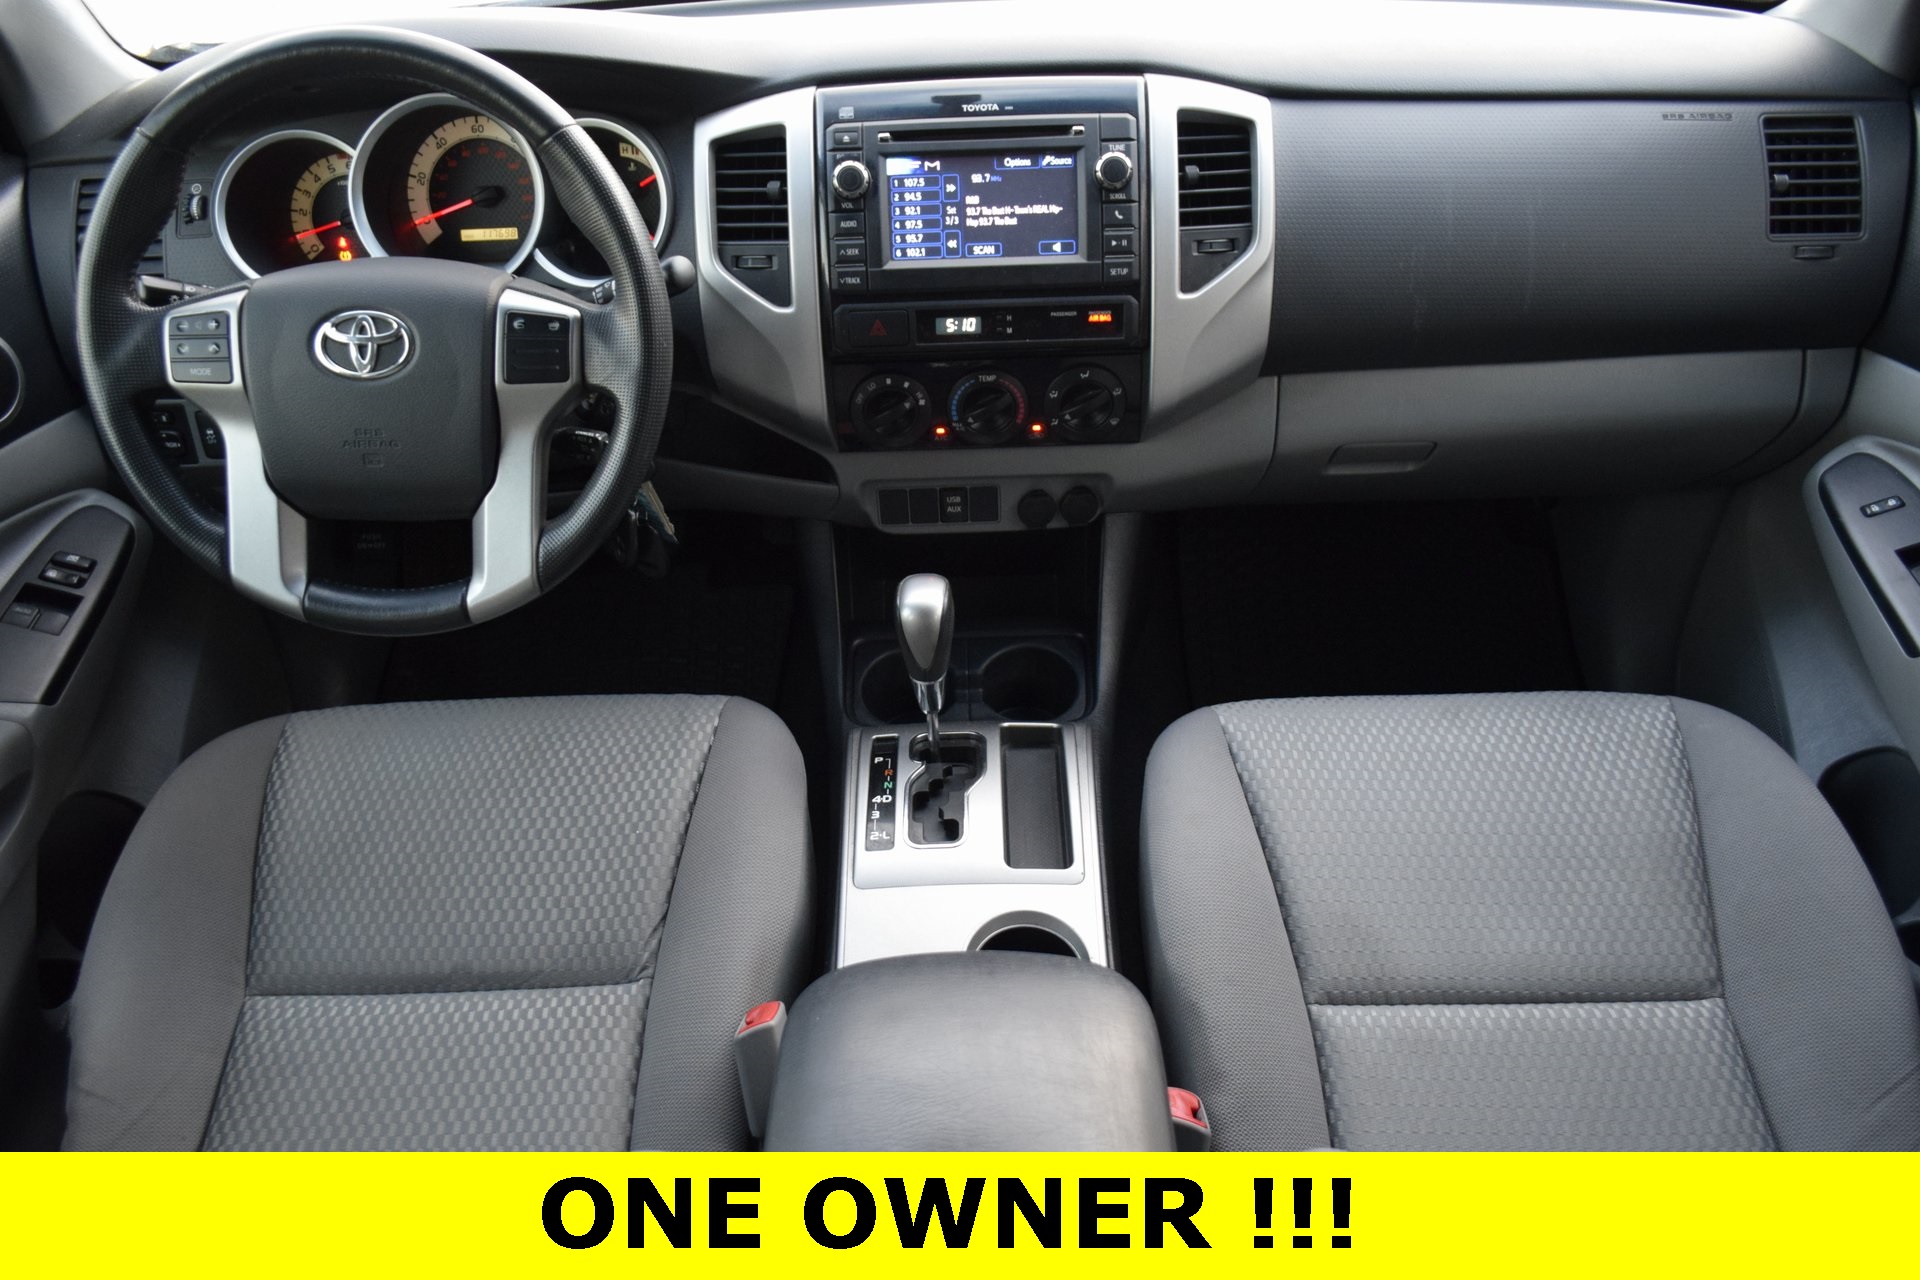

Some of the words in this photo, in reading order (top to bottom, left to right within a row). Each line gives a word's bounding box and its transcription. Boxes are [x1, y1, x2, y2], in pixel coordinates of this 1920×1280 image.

[961, 103, 1000, 112] TOYOTA
[471, 124, 484, 133] 60
[435, 137, 448, 150] 40
[1003, 157, 1032, 168] Options
[1050, 157, 1072, 166] Source
[327, 164, 336, 173] 5
[313, 174, 322, 183] 4
[416, 172, 427, 186] 20
[893, 179, 899, 188] 1
[903, 178, 925, 188] 107.5
[302, 190, 312, 198] 3
[893, 193, 900, 202] 2
[904, 191, 922, 201] 94.5
[298, 208, 308, 217] 2
[894, 207, 901, 216] 3
[904, 205, 921, 216] 92.1
[946, 205, 957, 215] Set
[840, 220, 857, 228] AUDIO
[894, 221, 901, 229] 4
[904, 220, 923, 229] 97.5
[945, 215, 960, 226] 3/3
[895, 235, 901, 243] 5
[905, 233, 924, 243] 95.7
[846, 248, 860, 256] SEEK
[895, 249, 902, 257] 6
[905, 247, 926, 257] 102.1
[972, 245, 995, 255] SCAN
[1109, 267, 1129, 276] SETUP
[1088, 314, 1099, 322] AIR
[1099, 314, 1112, 322] BAG
[945, 317, 977, 333] 5:10
[189, 368, 212, 376] MODE
[946, 505, 962, 513] AUX
[871, 811, 880, 819] 3
